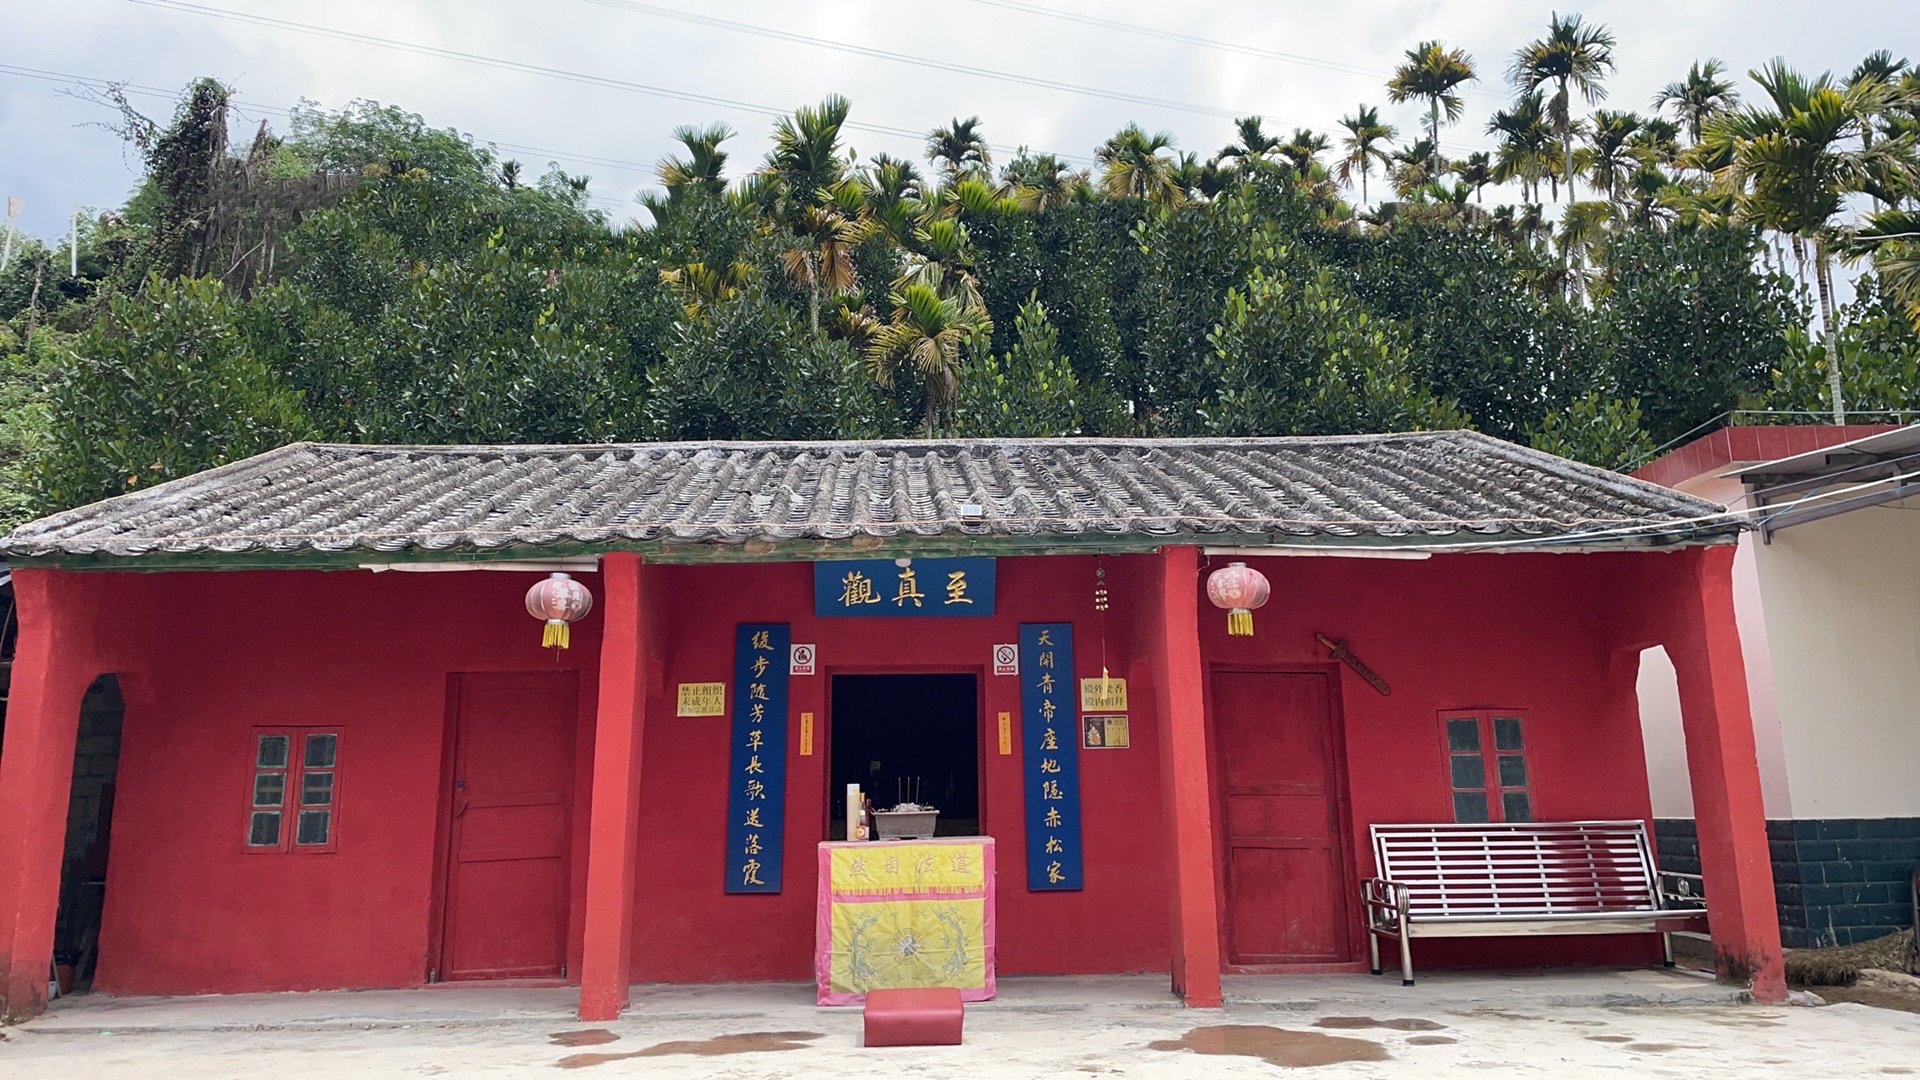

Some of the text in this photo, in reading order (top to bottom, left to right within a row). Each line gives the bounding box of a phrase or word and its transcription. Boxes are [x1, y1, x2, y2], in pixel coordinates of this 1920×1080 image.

[838, 568, 973, 608] 至真觀
[681, 686, 723, 696] 禁止组织
[682, 696, 722, 706] 未成年人
[850, 852, 972, 878] 道法自然
